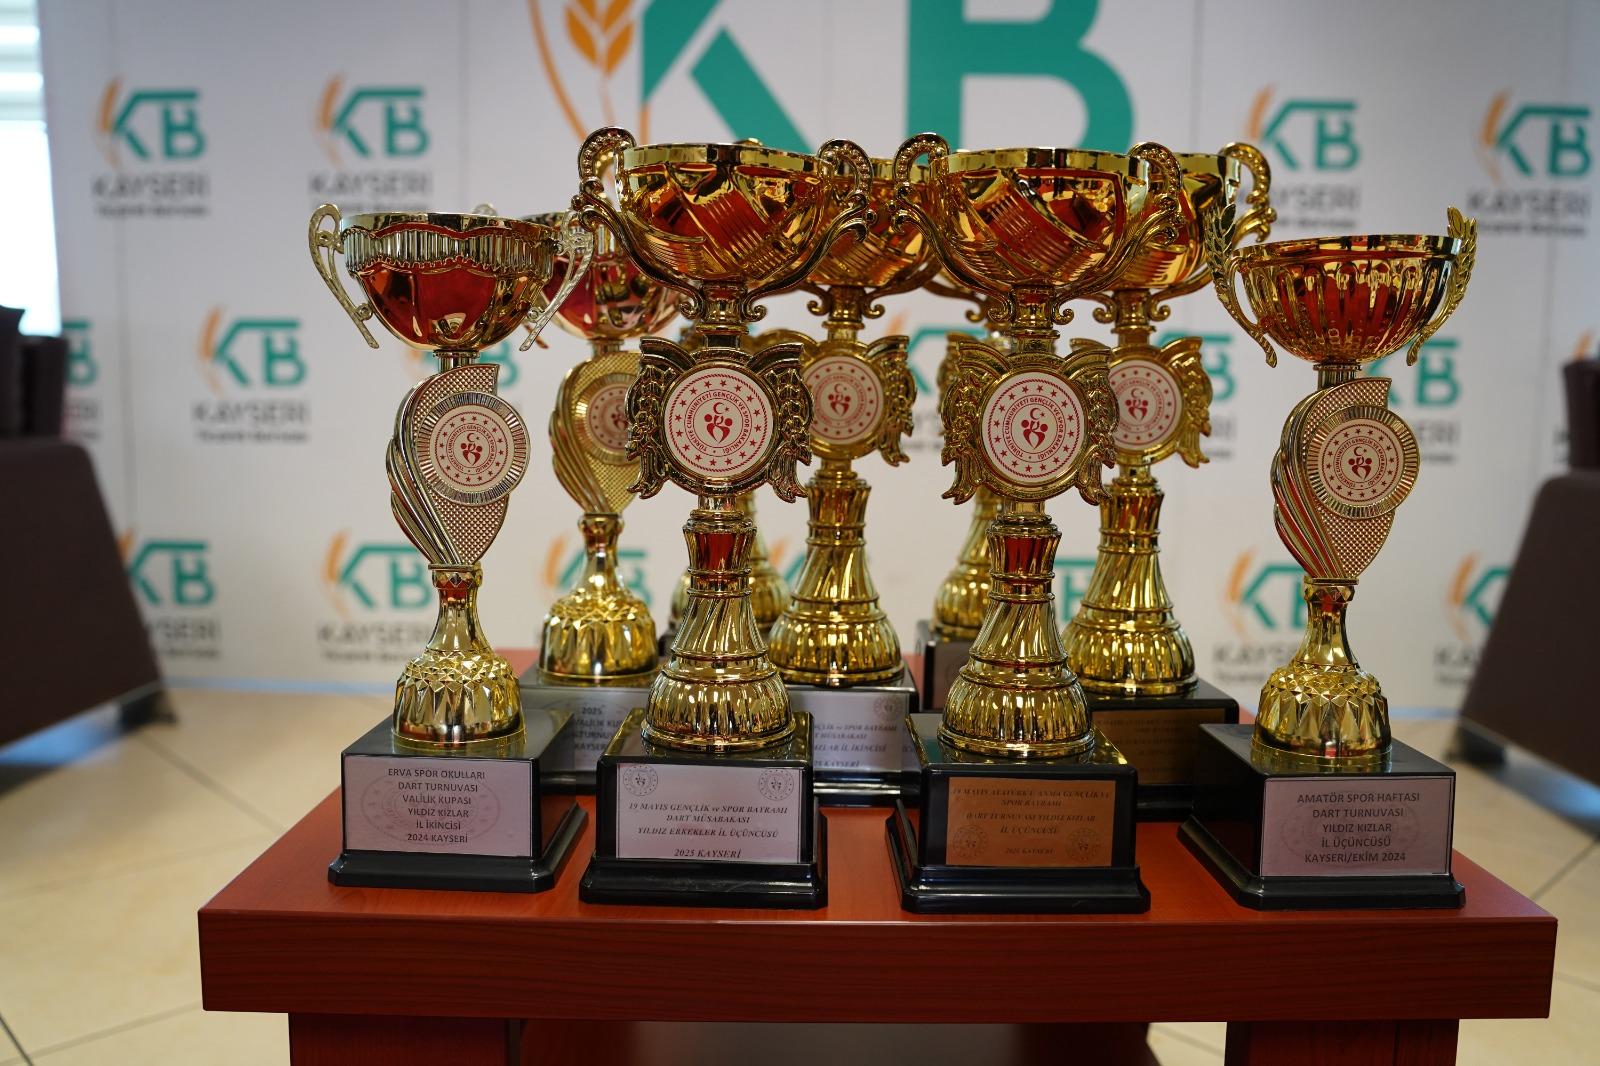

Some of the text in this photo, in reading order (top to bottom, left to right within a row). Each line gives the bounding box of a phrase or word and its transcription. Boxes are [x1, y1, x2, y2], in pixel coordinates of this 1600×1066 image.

[712, 391, 740, 403] GENÇLİK
[1029, 396, 1055, 409] GENÇLİK
[686, 392, 712, 428] CUMHURİYETİ
[1004, 397, 1029, 435] CUMHURİYETİ
[743, 409, 751, 428] SPOR
[1057, 415, 1065, 433] SPOR
[687, 429, 707, 452] TÜRKİYE
[722, 428, 750, 455] BAKANLIĞI
[1005, 435, 1024, 458] TÜRKİYE
[1037, 434, 1064, 461] BAKANLIĞI
[388, 768, 485, 780] ERVA SPOR OKULLARI
[398, 781, 478, 793] DART TURNUVASI
[402, 792, 471, 805] VALİLİK KUPASI
[1297, 791, 1420, 804] AMATÖR SPOR HAFTASI
[408, 808, 469, 818] YILDIZ KIZLAR
[629, 802, 637, 810] 19
[640, 803, 668, 811] MAYIS
[670, 803, 710, 814] GENÇLİK
[721, 805, 746, 813] SPOR
[747, 806, 788, 814] BAYRAMI
[1312, 808, 1404, 818] DART TURNUVASI
[666, 812, 751, 823] DART MÜSABAKASI
[416, 820, 461, 831] İL İKİNCİSİ
[1322, 823, 1392, 833] YILDIZ KIZLAR
[638, 827, 667, 835] YILDIZ
[669, 827, 718, 836] ERKEKLER
[718, 827, 727, 837] İL
[407, 833, 468, 844] 2024 KAYSERİ
[1321, 837, 1391, 849] İL ÜÇÜNCÜSÜ
[674, 848, 742, 859] 2025 KAYSERİ
[1304, 851, 1406, 864] KAYSERİ/EKİM 2024
